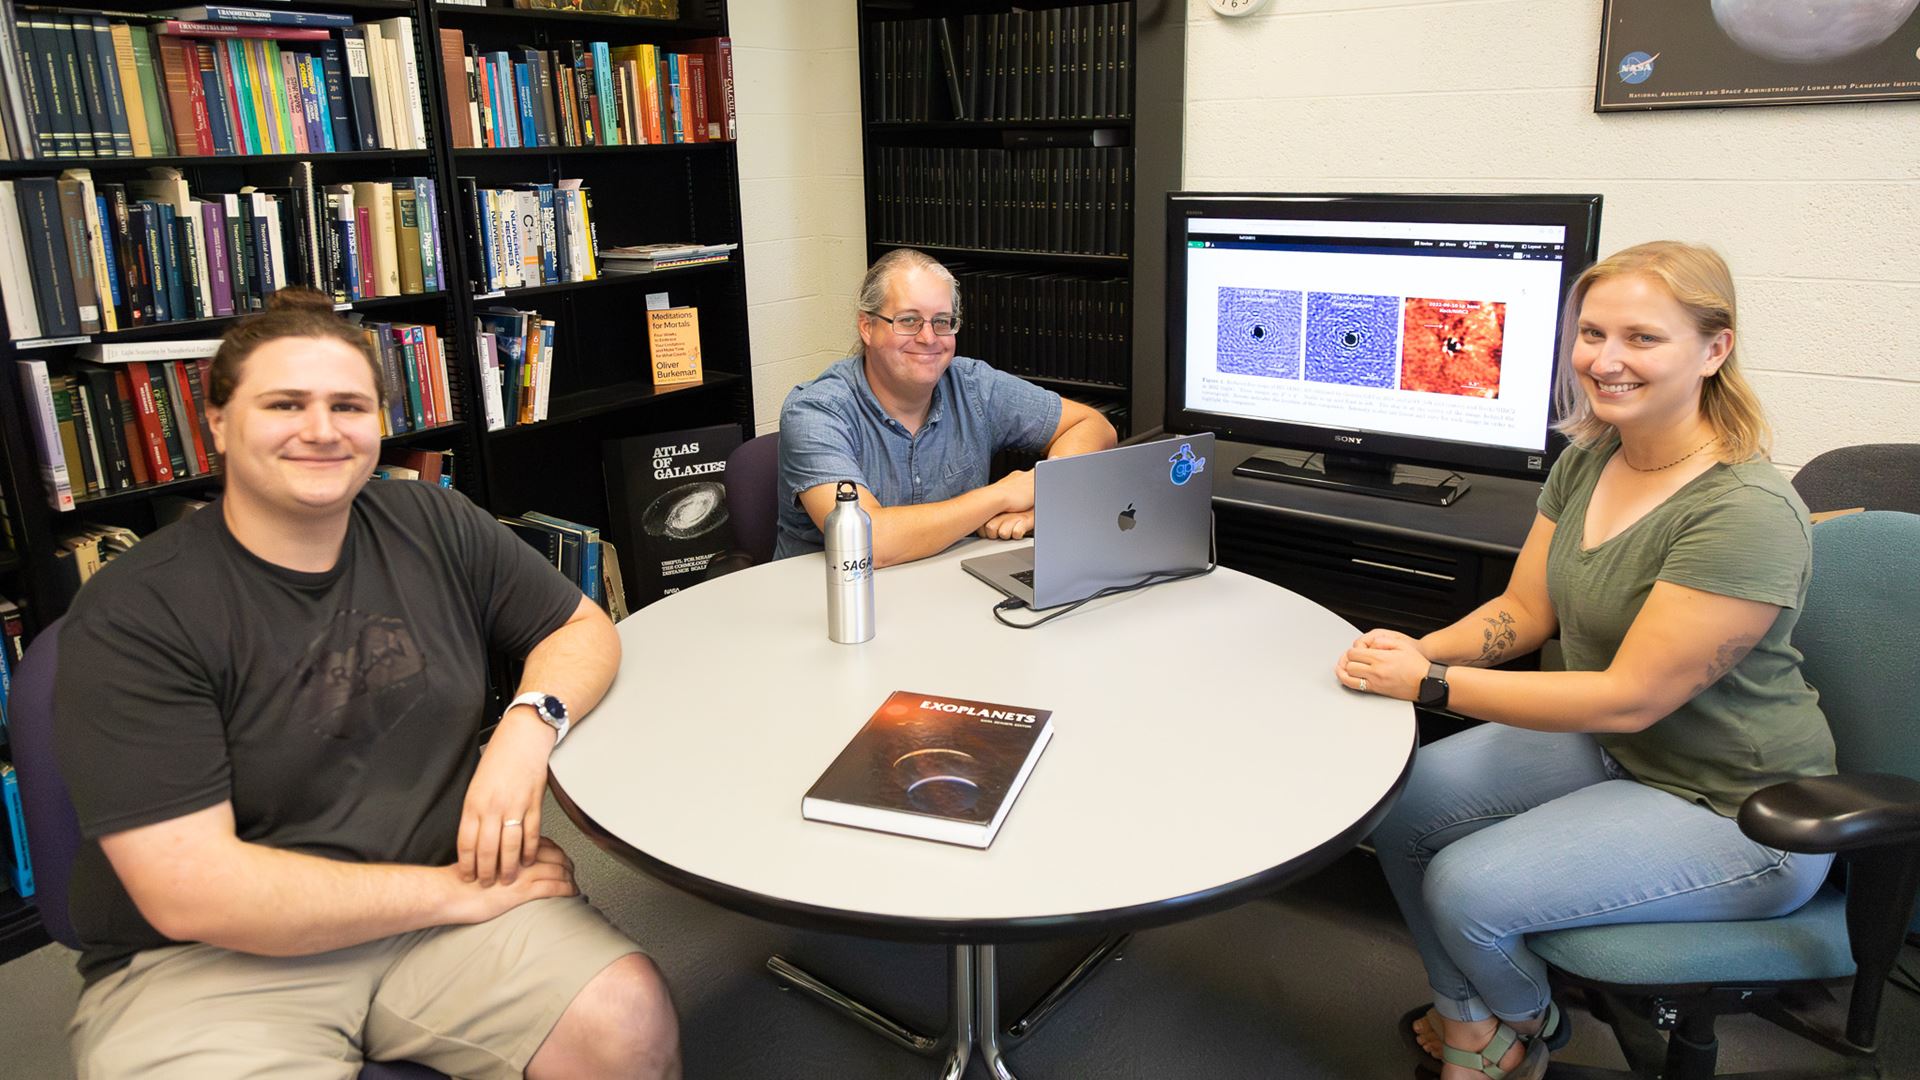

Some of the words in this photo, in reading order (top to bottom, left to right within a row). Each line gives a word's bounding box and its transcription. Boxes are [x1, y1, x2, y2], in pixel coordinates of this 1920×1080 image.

[1231, 0, 1237, 8] 6
[727, 78, 735, 121] CALCULU
[260, 224, 268, 252] Theoretical
[348, 222, 357, 255] PHYSICS
[523, 214, 535, 241] C++
[549, 207, 558, 271] NUMERICAL
[424, 232, 434, 267] Physics
[491, 210, 501, 277] NUMERICAL
[505, 220, 514, 266] RECIPES
[510, 210, 520, 275] NUMERICAL
[150, 229, 158, 265] Astrophysical
[154, 266, 163, 291] Concepts
[191, 256, 199, 287] Astronomy
[235, 253, 244, 285] Astrophysics
[263, 253, 272, 284] Astrophysics
[652, 311, 693, 321] Meditations
[653, 322, 663, 330] for
[664, 320, 691, 329] Mortals
[533, 335, 539, 343] 6
[656, 361, 679, 370] Oliver
[657, 369, 697, 379] Burkeman
[156, 400, 171, 438] MATERIALS
[652, 442, 700, 459] ATLAS
[1334, 435, 1362, 445] SONY
[652, 456, 673, 470] OF
[653, 460, 727, 481] GALAXIES
[661, 559, 683, 567] USEFUL
[662, 567, 689, 577] DISTANCE
[674, 559, 709, 569] COSMOLOGIC
[919, 699, 1037, 725] EXOPLANETS
